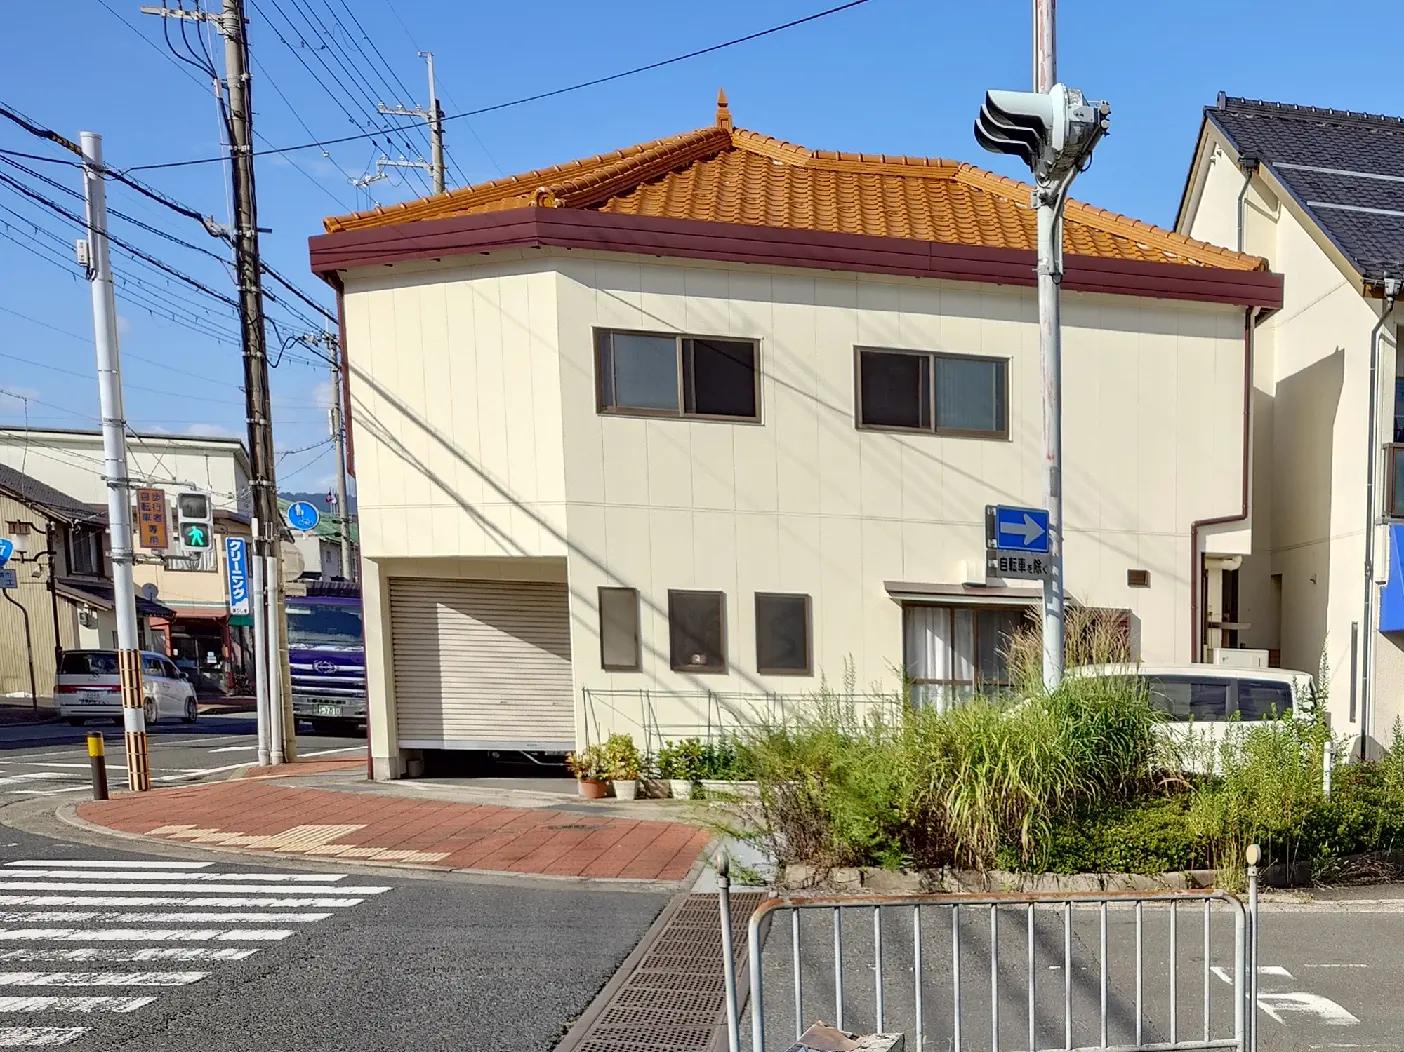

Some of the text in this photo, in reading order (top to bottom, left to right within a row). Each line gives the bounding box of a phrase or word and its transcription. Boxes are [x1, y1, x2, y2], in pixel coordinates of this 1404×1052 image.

[229, 540, 245, 600] クリーニング
[999, 557, 1048, 574] 自転車を除く
